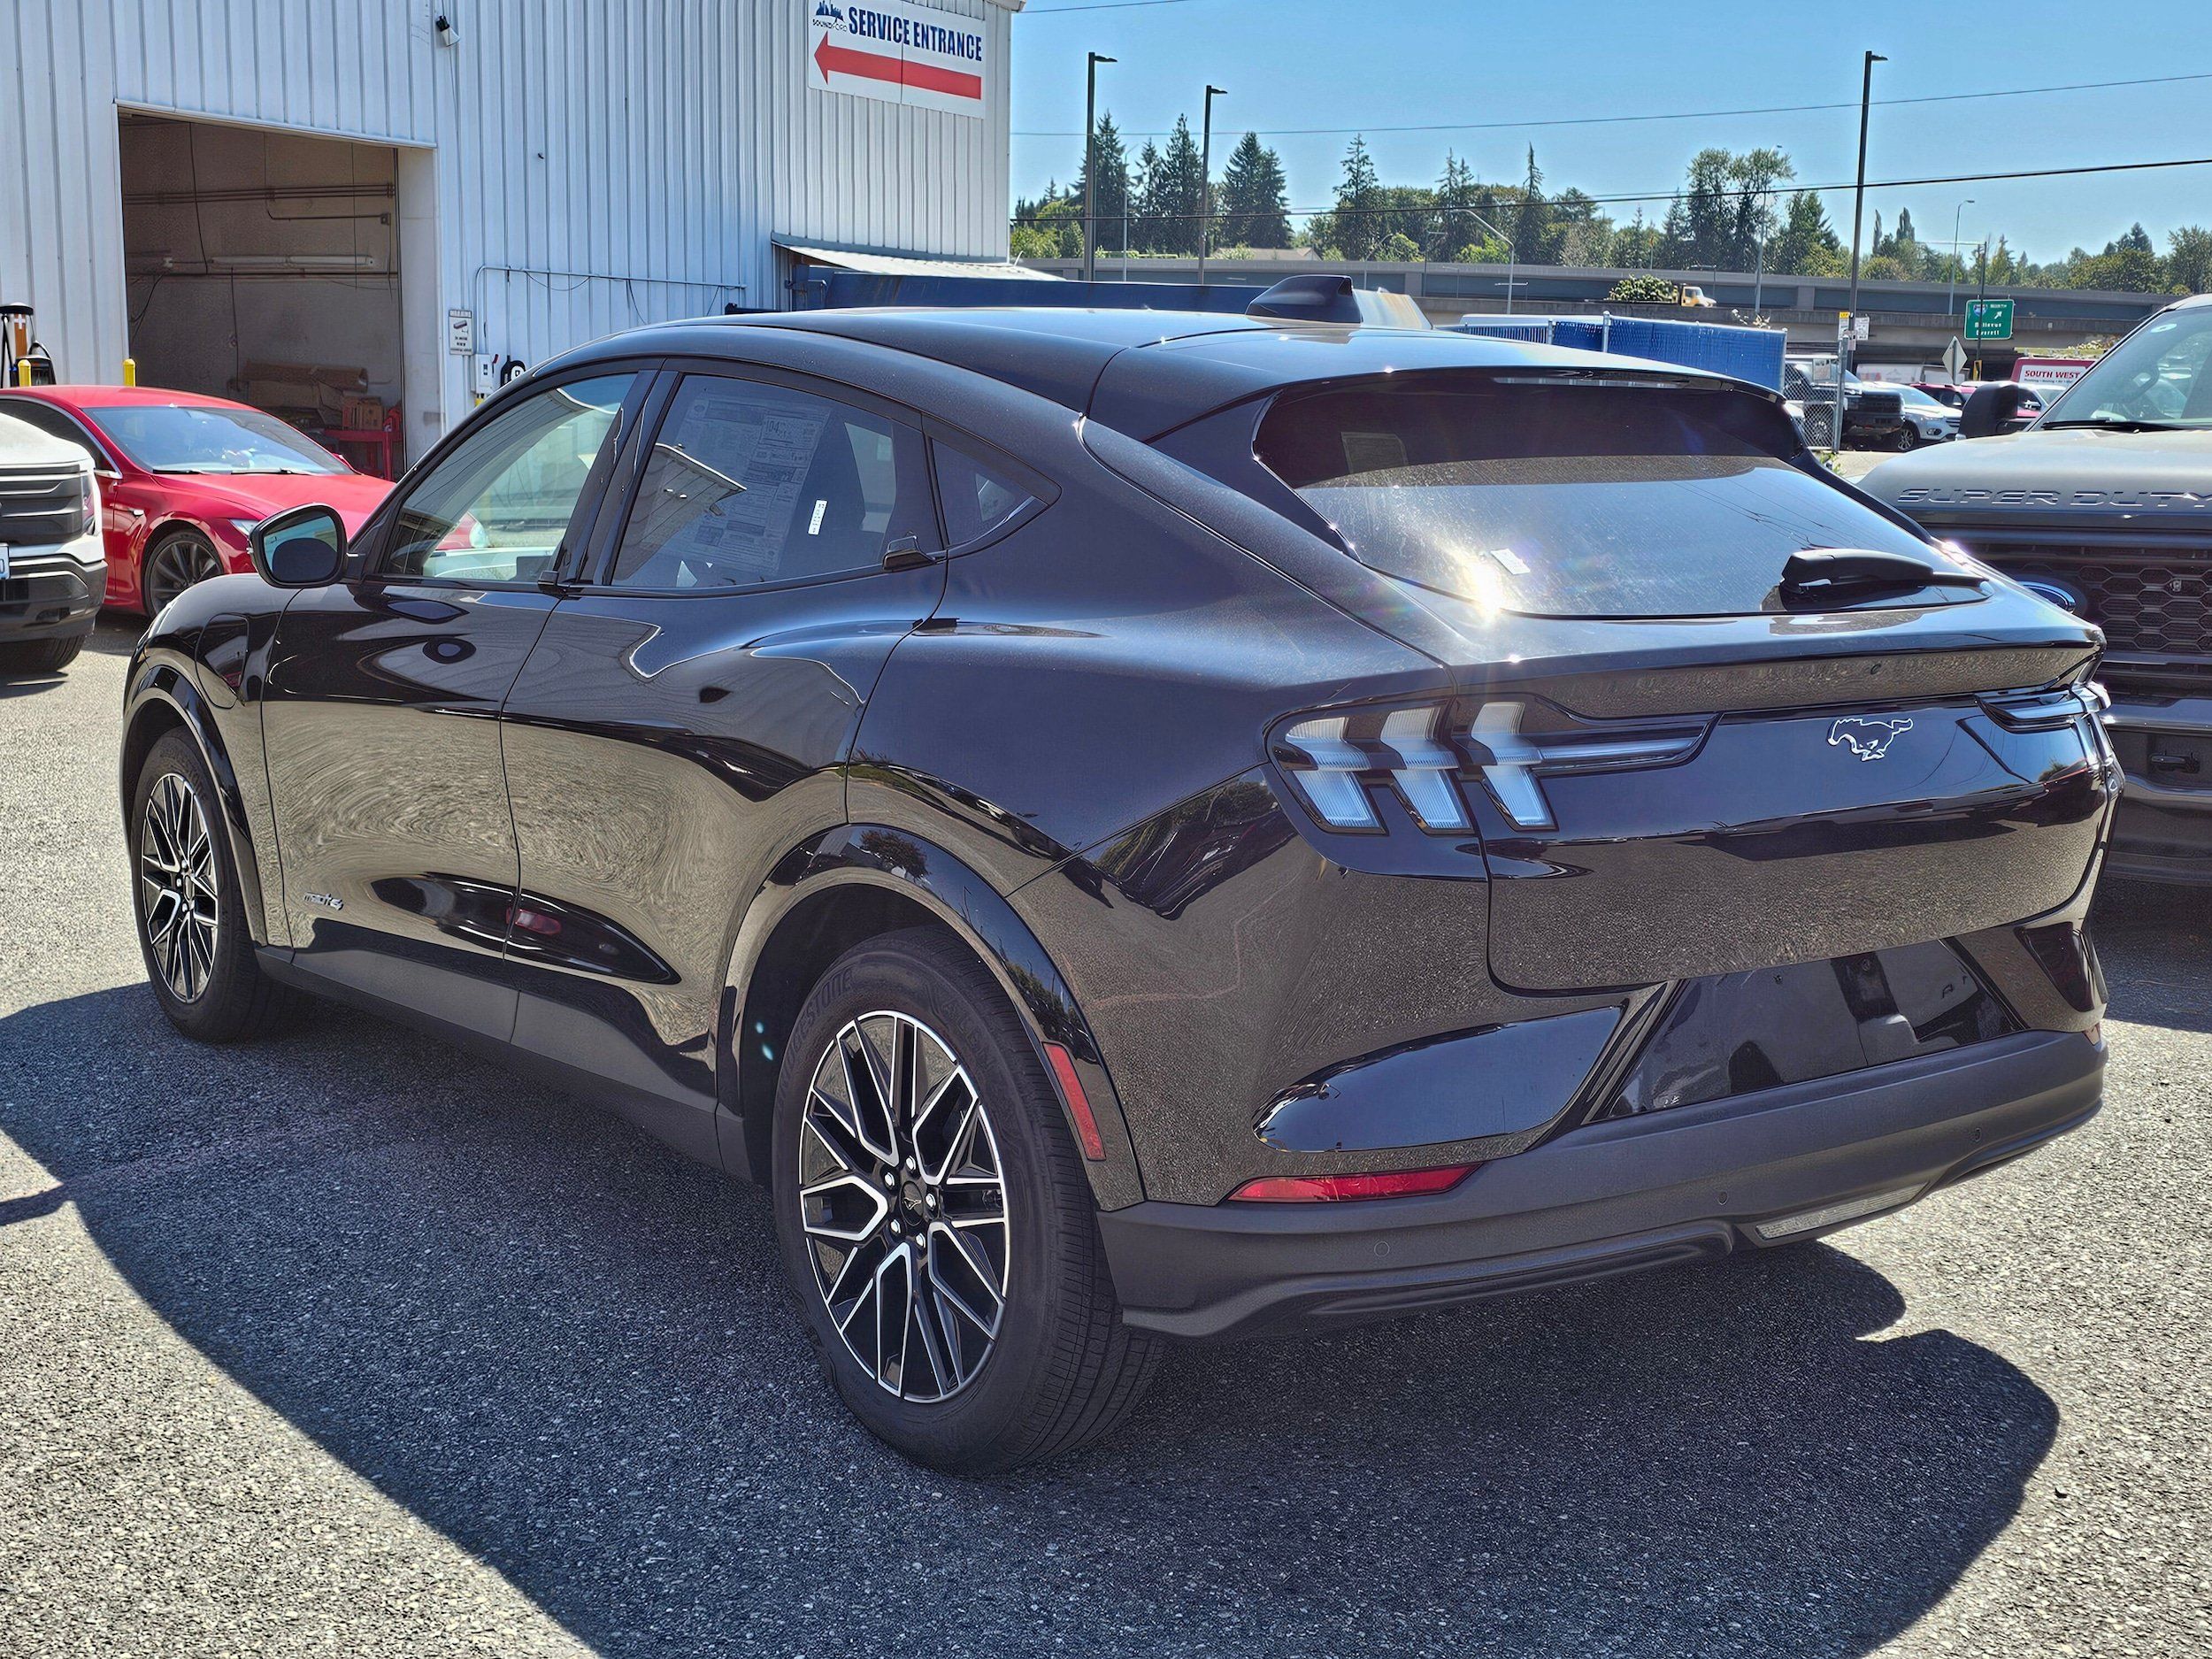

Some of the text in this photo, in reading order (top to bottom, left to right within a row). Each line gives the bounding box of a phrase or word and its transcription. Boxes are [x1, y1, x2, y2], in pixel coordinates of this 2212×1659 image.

[848, 6, 982, 62] SERVICE ENTRANCE
[1897, 488, 2212, 508] SUPER DUTY
